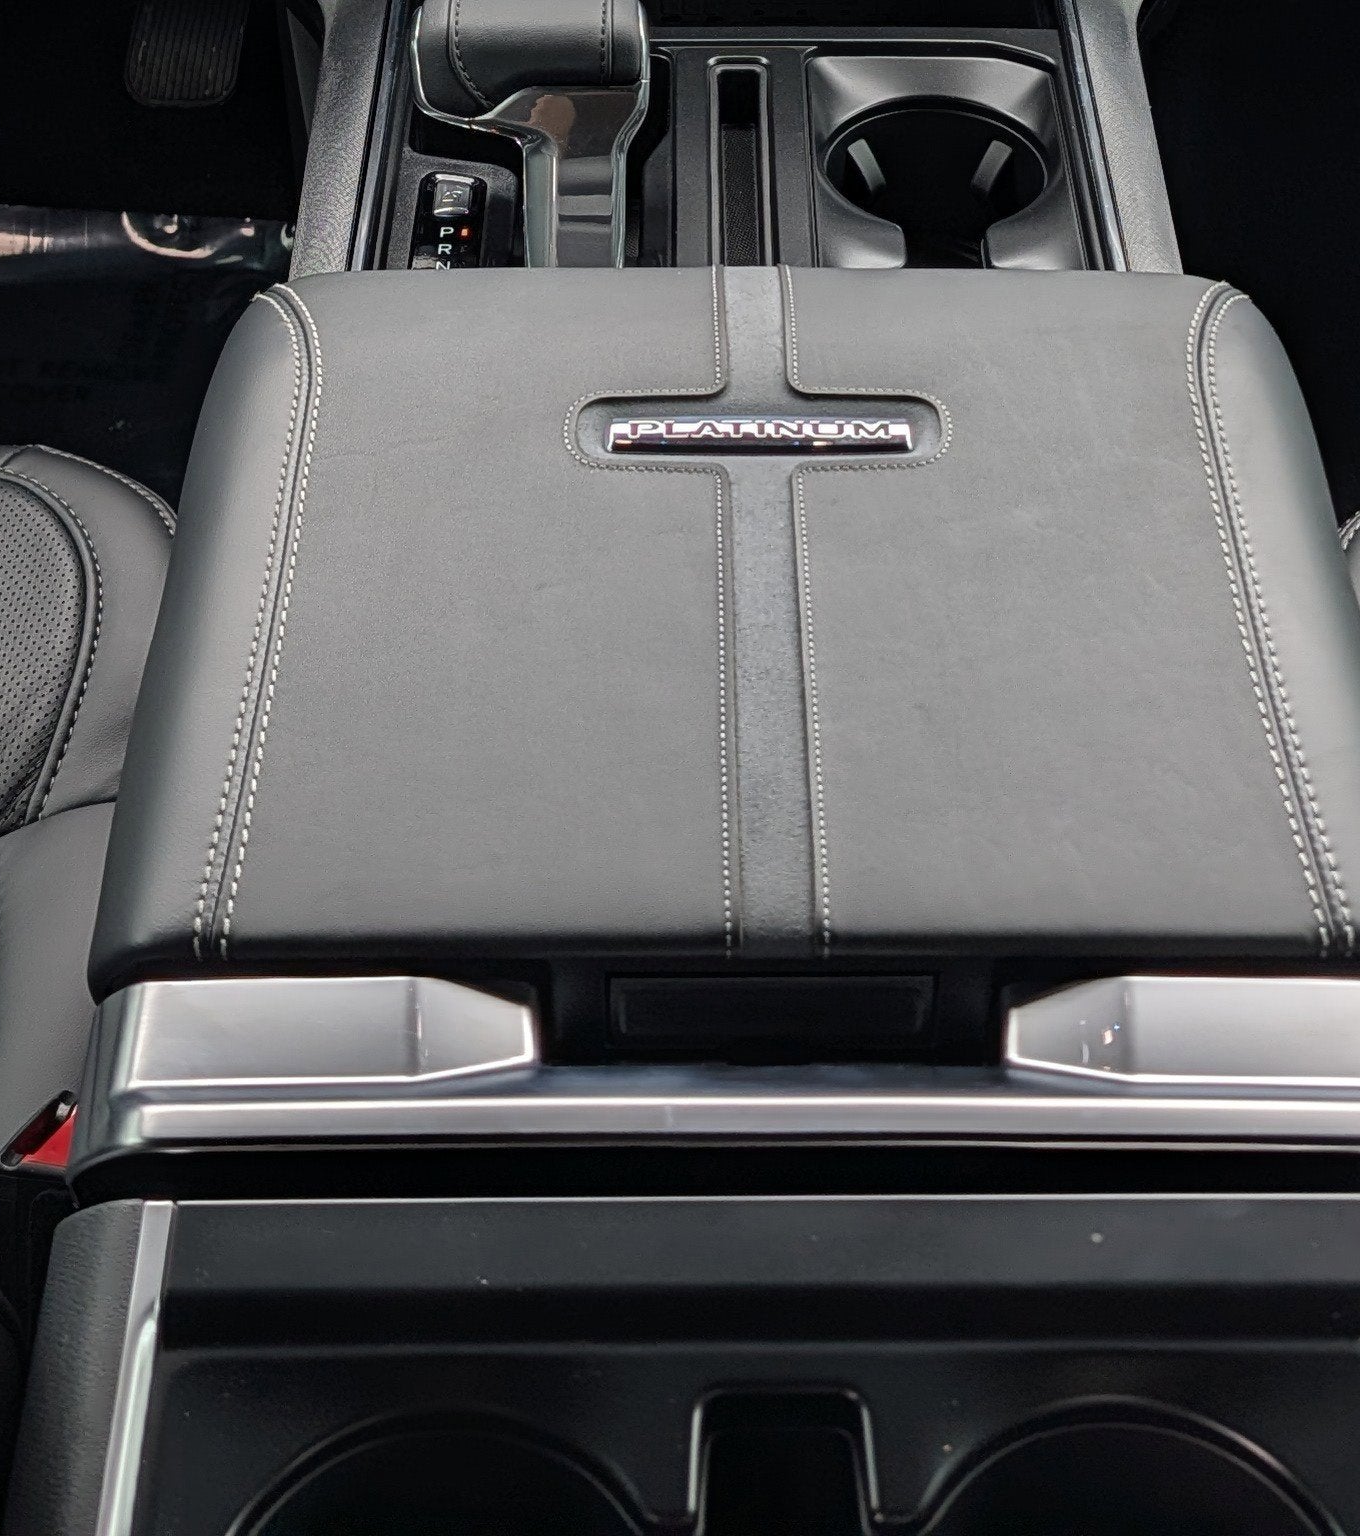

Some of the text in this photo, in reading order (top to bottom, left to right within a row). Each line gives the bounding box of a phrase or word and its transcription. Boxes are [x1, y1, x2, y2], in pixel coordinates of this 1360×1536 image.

[439, 226, 454, 238] P
[437, 243, 453, 255] R
[435, 260, 451, 270] N
[627, 419, 894, 440] PLATINUM
